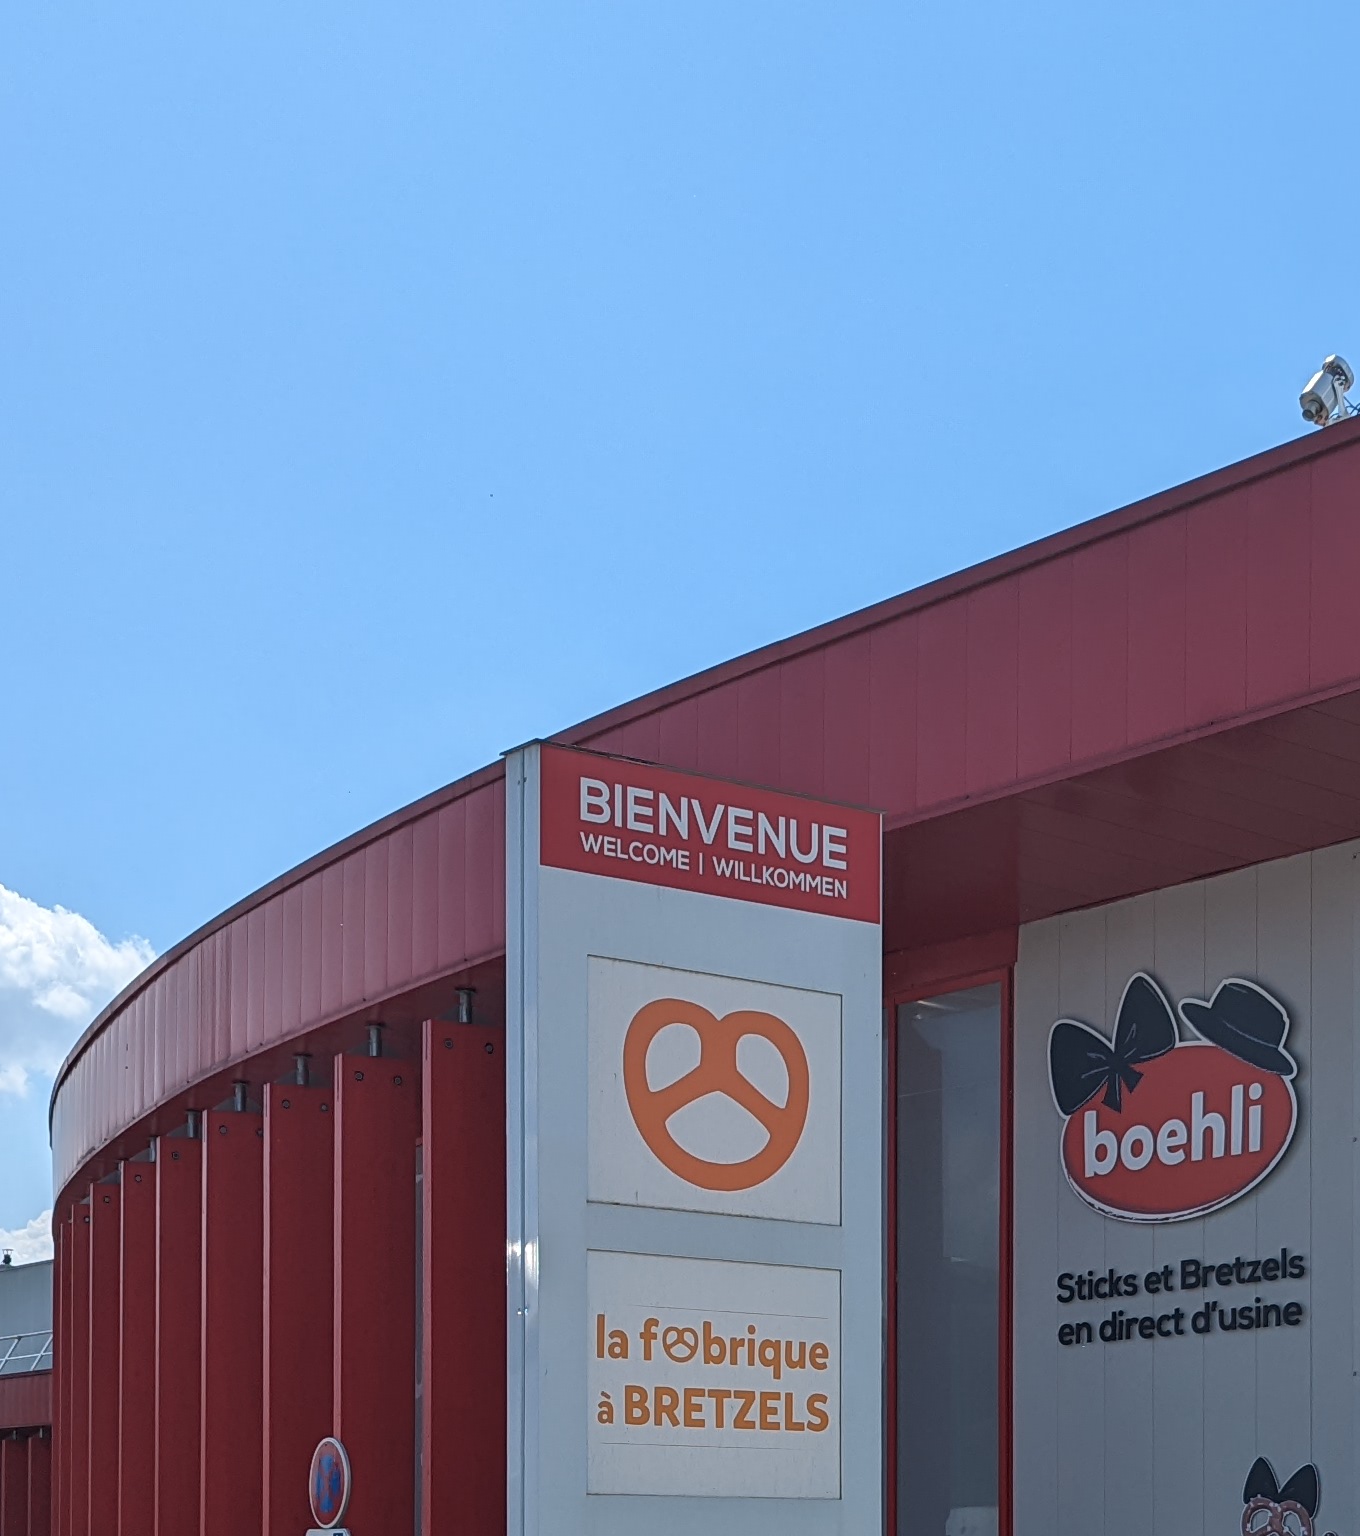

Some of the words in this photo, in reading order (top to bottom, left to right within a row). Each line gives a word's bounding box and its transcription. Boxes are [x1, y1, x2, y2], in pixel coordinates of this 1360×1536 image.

[579, 776, 848, 870] BIENVENUE
[580, 831, 690, 871] WELCOME
[712, 855, 848, 900] WILLKOMMEN
[1083, 1082, 1263, 1178] boehli
[1056, 1268, 1138, 1303] Sticks
[1144, 1264, 1174, 1294] et
[1180, 1247, 1306, 1291] Bretzels
[596, 1314, 629, 1360] la
[1057, 1321, 1093, 1346] en
[1098, 1305, 1185, 1343] direct
[1190, 1297, 1304, 1334] d'usine
[597, 1391, 615, 1425] à
[624, 1385, 830, 1432] BRETZELS
